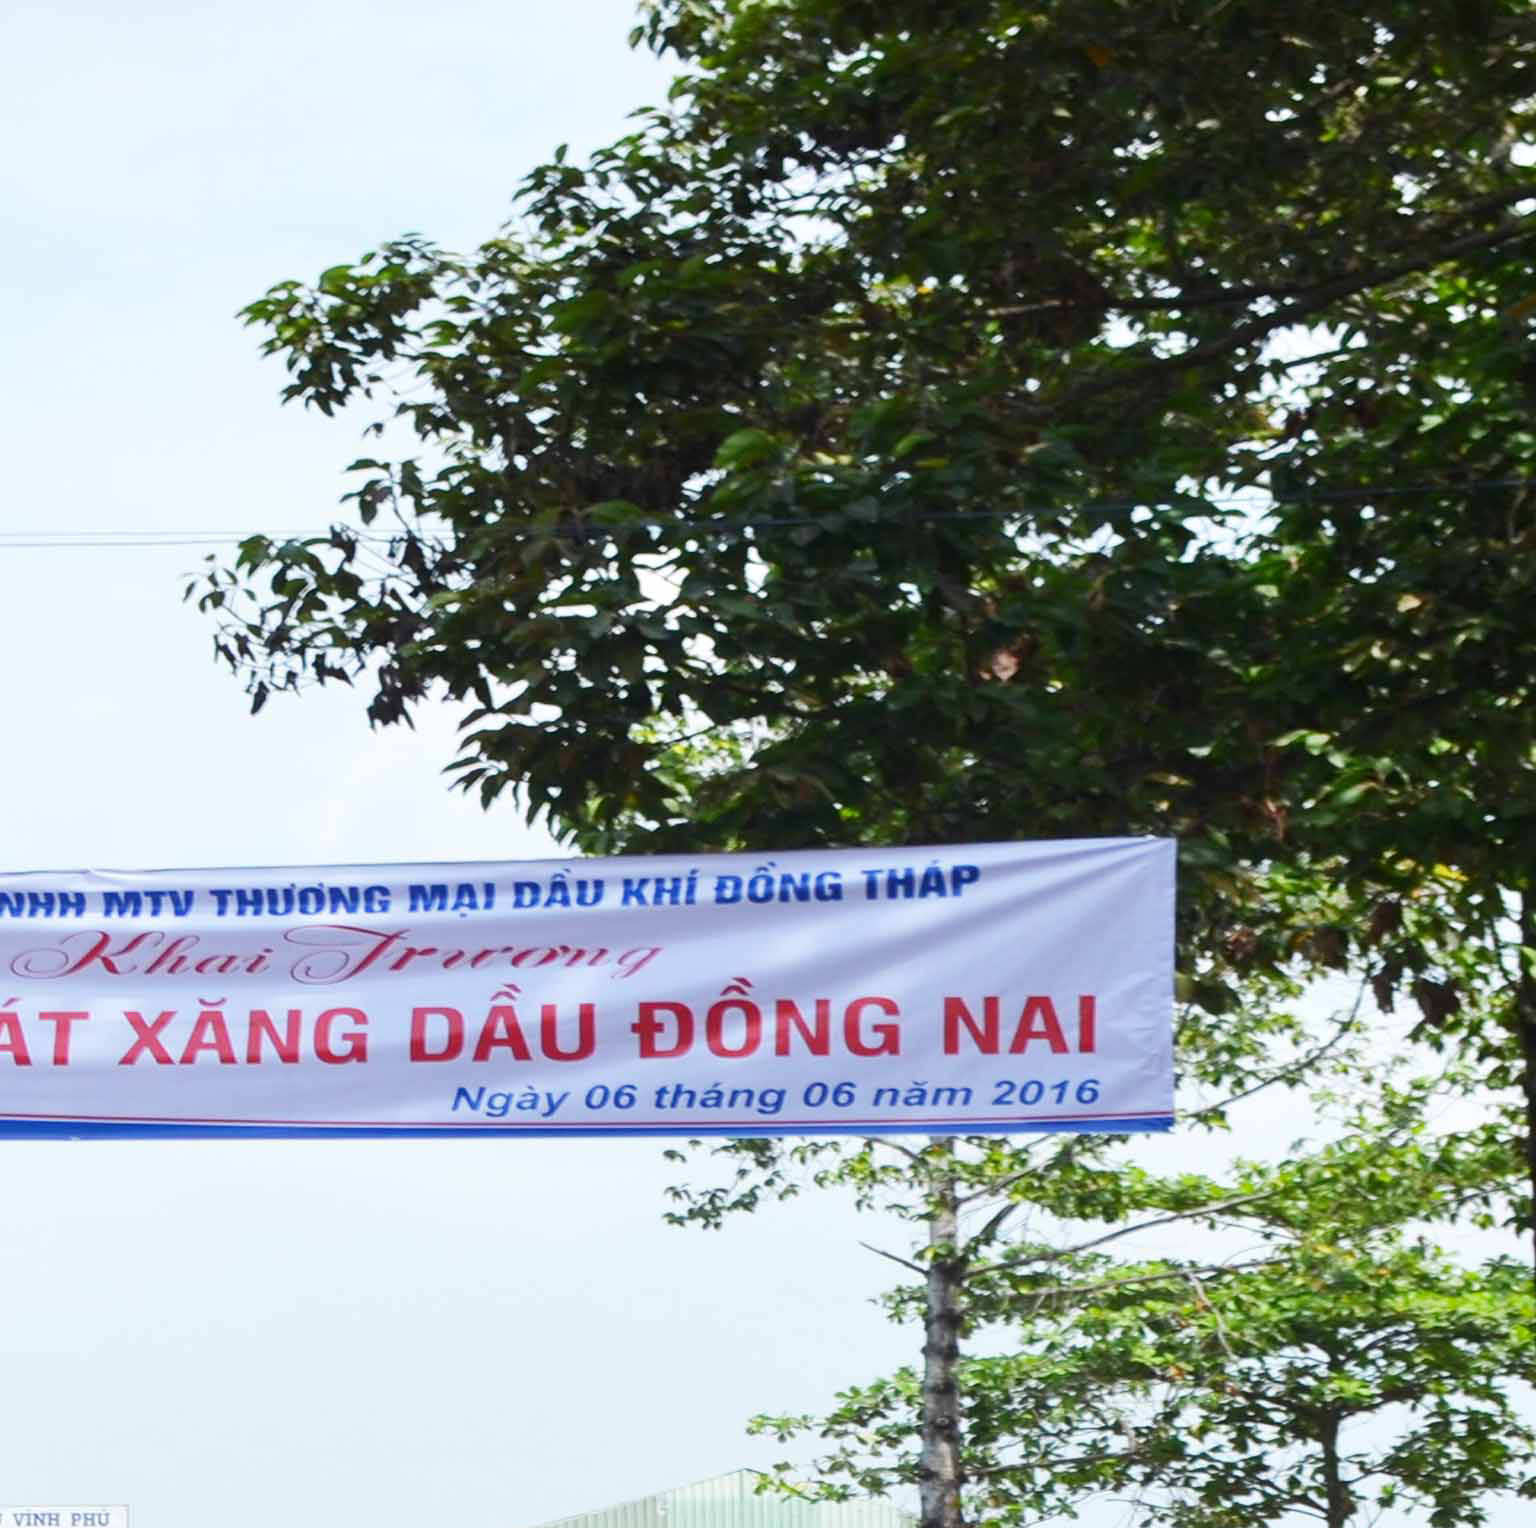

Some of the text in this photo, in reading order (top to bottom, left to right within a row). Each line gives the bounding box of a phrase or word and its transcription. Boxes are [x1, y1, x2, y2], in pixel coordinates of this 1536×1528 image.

[99, 888, 197, 918] MTV
[208, 882, 394, 918] THƯƠNG
[407, 879, 498, 919] MẠI
[510, 867, 607, 910] DẦU
[620, 869, 701, 908] KHÍ
[713, 861, 848, 906] ĐỒNG
[860, 860, 983, 901] THÁP
[10, 924, 663, 986] Khai Trương
[119, 997, 369, 1065] XĂNG
[409, 984, 596, 1063] DẦU
[632, 977, 900, 1059] ĐỒNG
[943, 995, 1096, 1056] NAI
[451, 1078, 1101, 1118] Ngày 06 tháng 06 năm 2016
